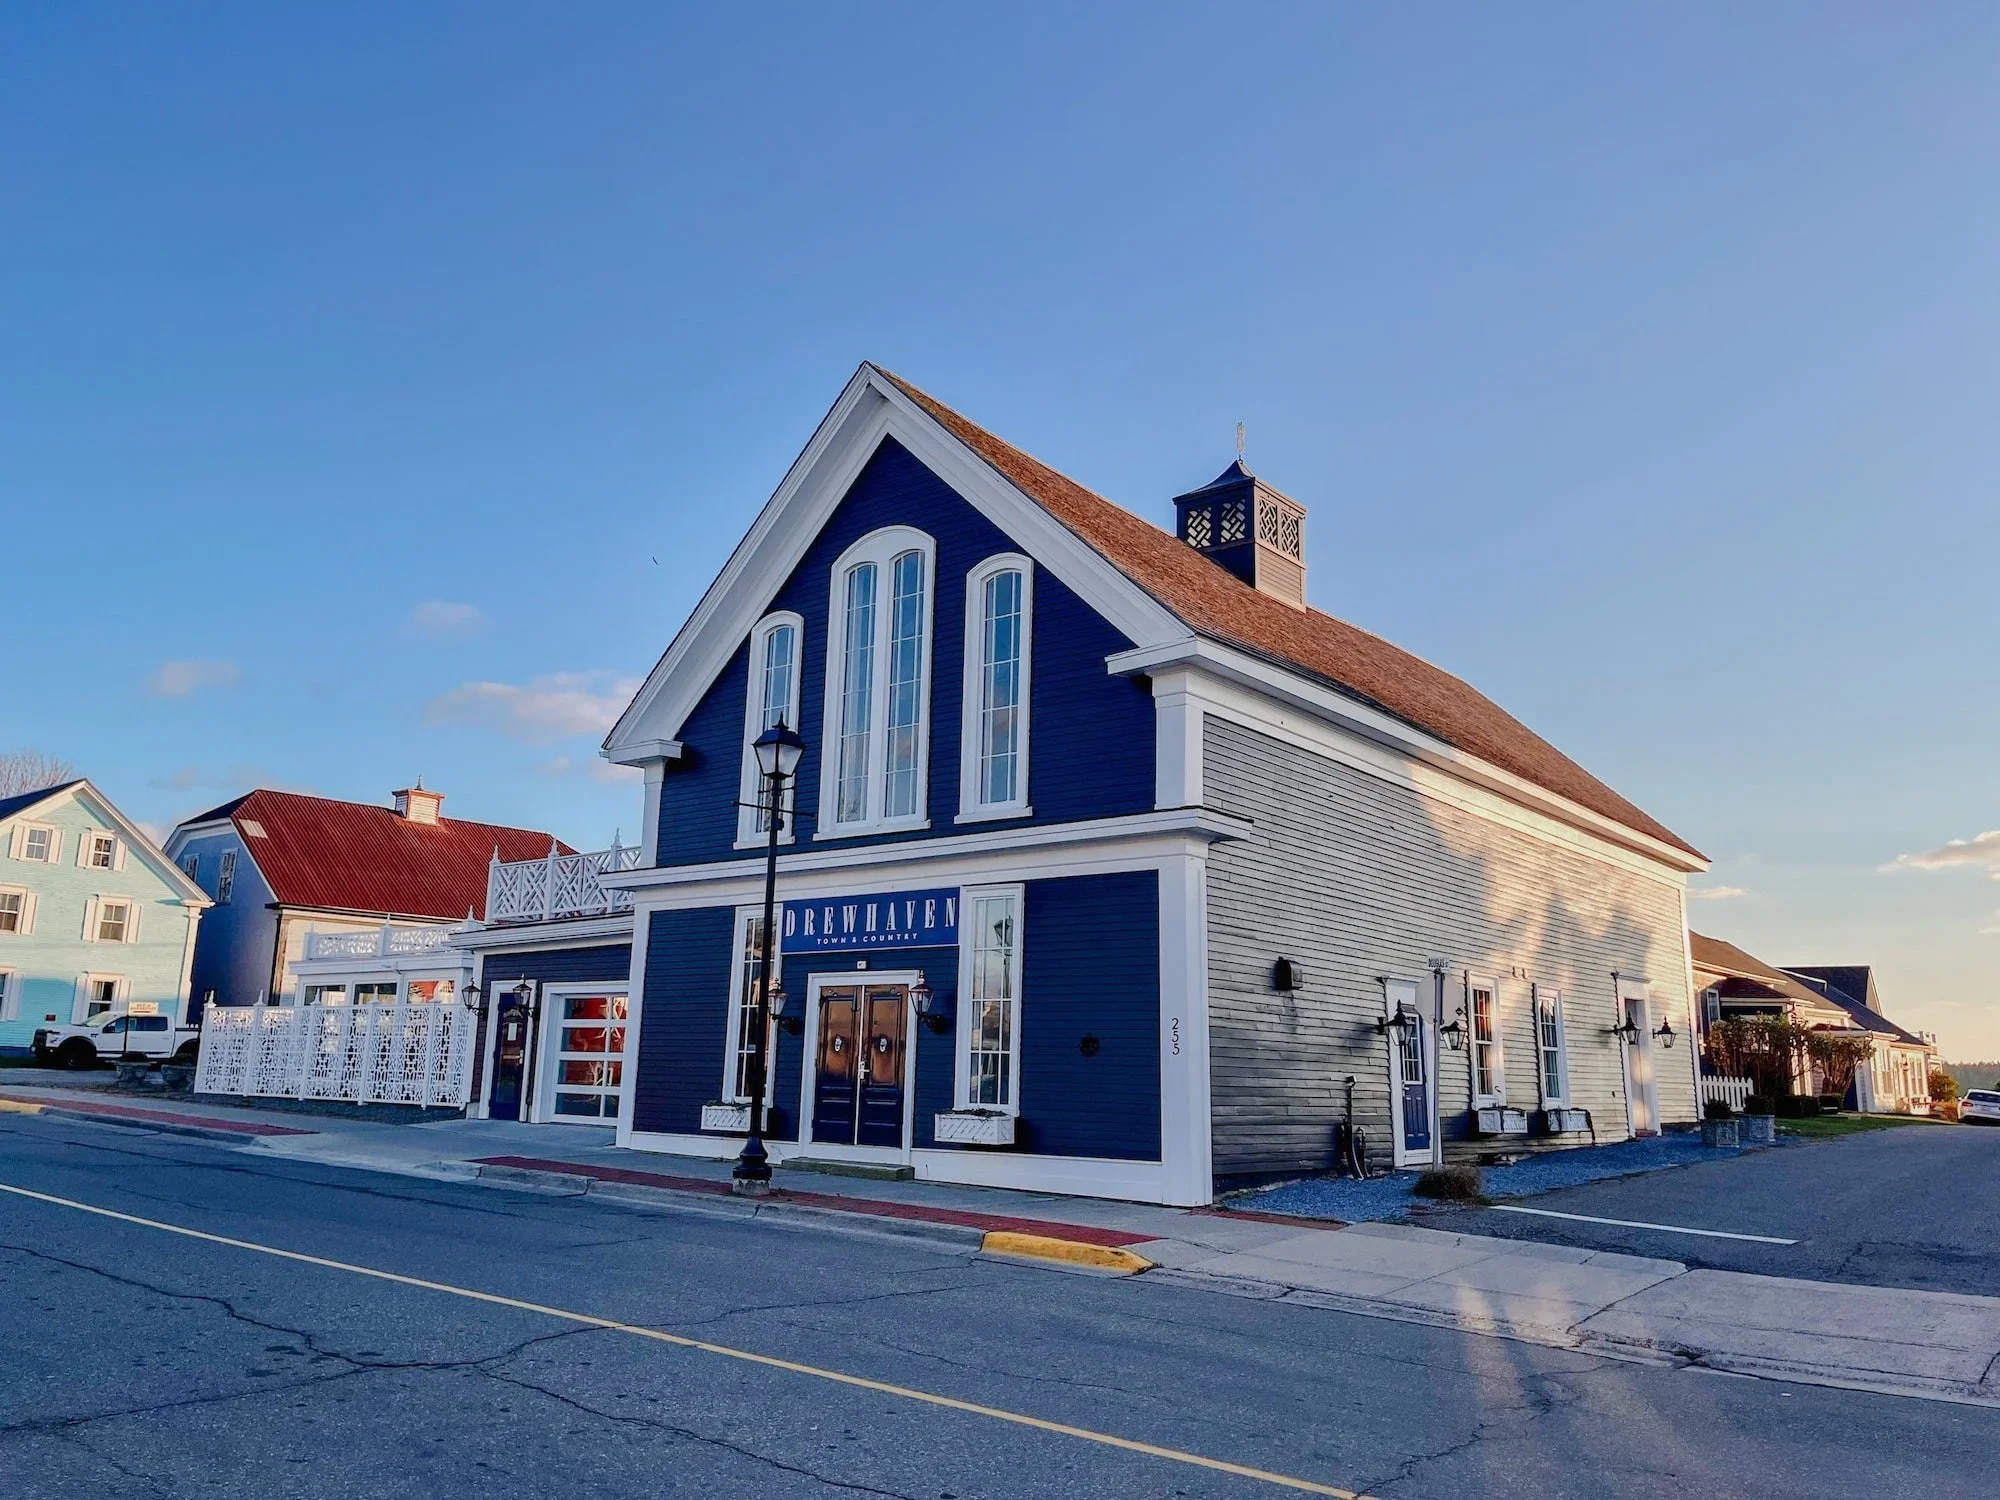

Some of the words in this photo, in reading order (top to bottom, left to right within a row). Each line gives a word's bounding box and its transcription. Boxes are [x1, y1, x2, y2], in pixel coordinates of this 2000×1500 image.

[785, 897, 957, 937] DREWHAVEN
[817, 937, 847, 945] TOWN
[862, 932, 918, 943] COUNTRY
[1171, 1017, 1180, 1056] 255
